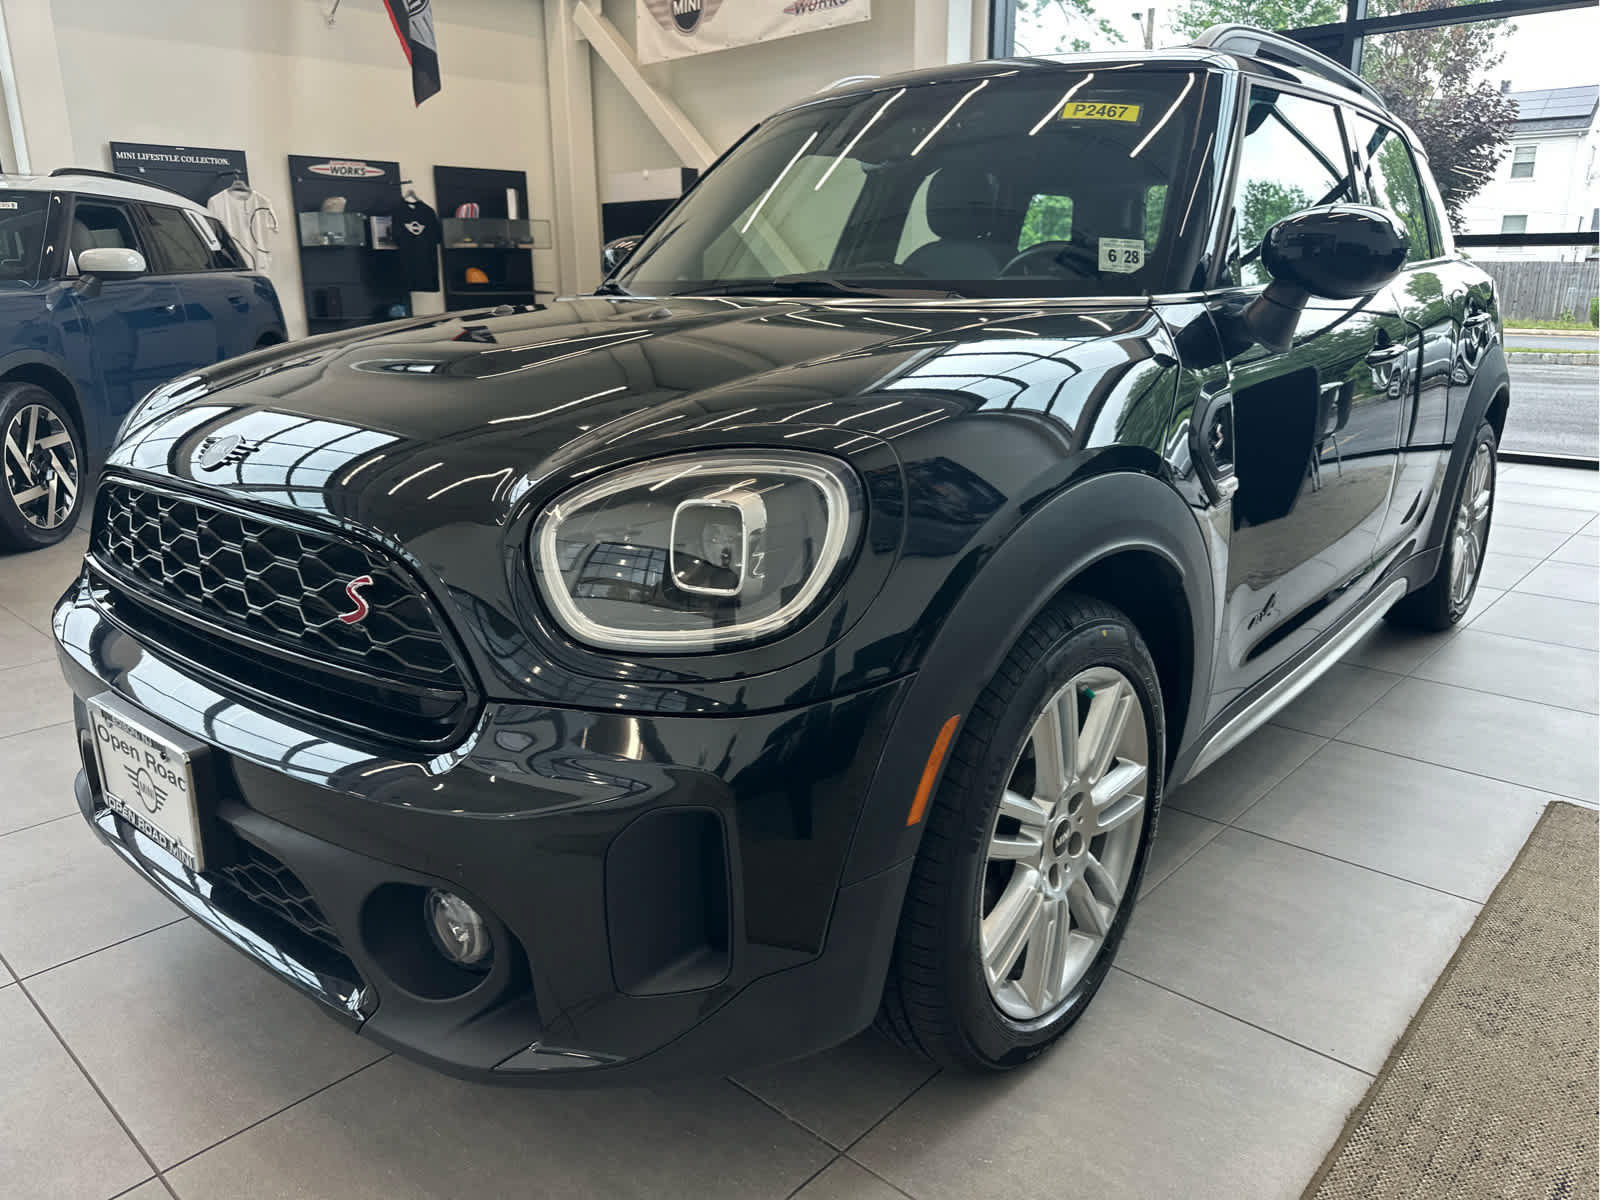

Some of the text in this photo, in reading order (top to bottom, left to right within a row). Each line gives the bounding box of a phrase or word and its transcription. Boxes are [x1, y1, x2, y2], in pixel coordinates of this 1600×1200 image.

[673, 0, 701, 15] MINI
[1073, 104, 1128, 118] P2467
[115, 151, 136, 160] MINI
[137, 152, 179, 163] LIFESTYLE
[330, 166, 366, 176] WORKS
[1108, 249, 1139, 264] 6 28
[338, 575, 374, 624] S
[97, 724, 140, 762] Open
[109, 796, 194, 870] OPEN ROAD MINI
